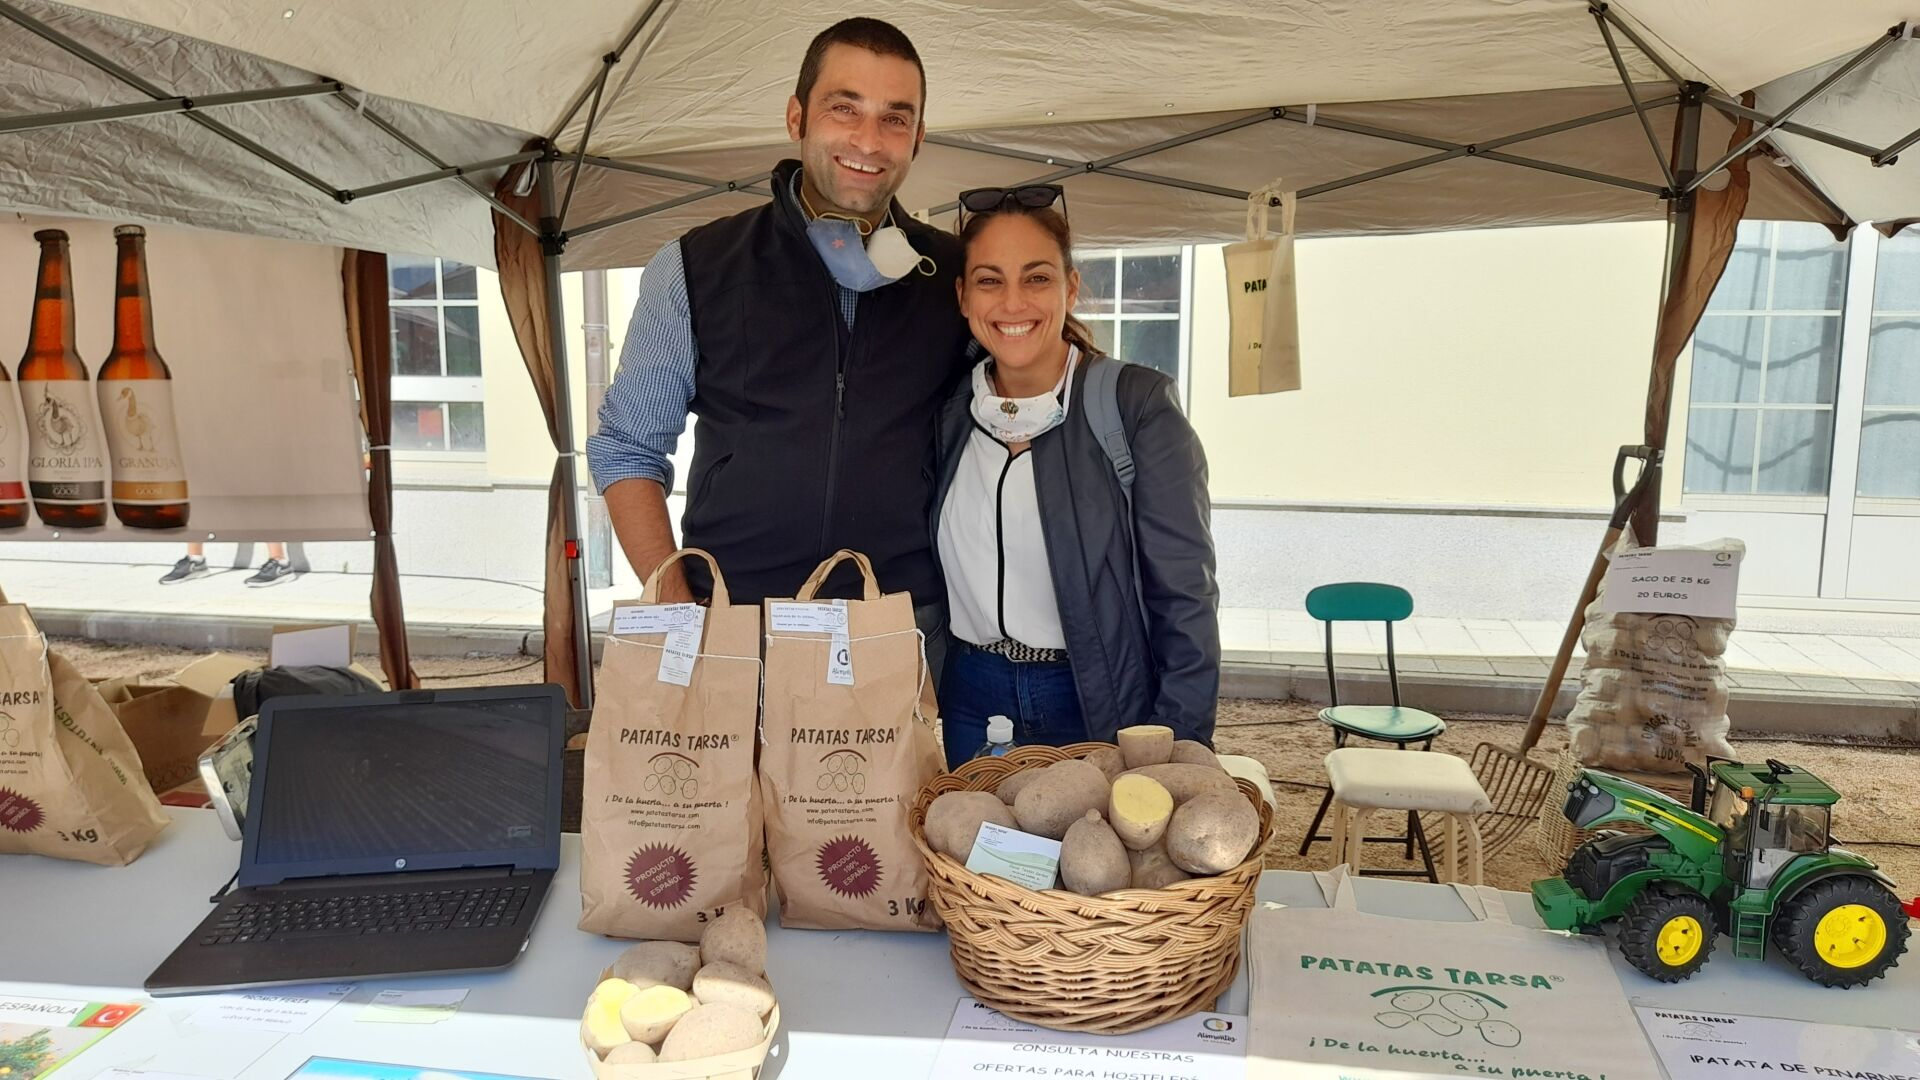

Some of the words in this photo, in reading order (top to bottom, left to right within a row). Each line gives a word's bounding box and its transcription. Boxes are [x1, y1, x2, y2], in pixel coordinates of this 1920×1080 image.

[1244, 279, 1267, 293] PATA
[31, 456, 81, 469] GLORIA
[83, 456, 103, 469] IPA
[118, 456, 178, 470] GRANUJA
[1632, 575, 1659, 583] SACO
[1663, 575, 1677, 583] DE
[1681, 576, 1693, 584] 25
[1697, 577, 1711, 585] KG
[1653, 591, 1688, 600] EUROS
[0, 690, 40, 706] ARSA
[620, 728, 681, 748] PATATAS
[790, 728, 850, 745] PATATAS
[1655, 746, 1686, 764] 100%
[611, 794, 623, 803] De
[788, 795, 798, 803] De
[72, 828, 99, 843] Kg
[827, 845, 862, 874] PRODUCTO
[843, 860, 860, 874] 100%
[634, 855, 676, 884] PRODUCTO
[651, 869, 671, 884] 100%
[887, 899, 899, 917] 3
[696, 911, 708, 923] 3
[1300, 955, 1434, 981] PATATAS
[1654, 1011, 1698, 1021] PATATAS
[1323, 1038, 1351, 1049] De
[1357, 1041, 1380, 1052] la
[1013, 1043, 1099, 1056] CONSULTA
[1106, 1048, 1195, 1064] NUESTRAS
[972, 1062, 1048, 1075] OFERTAS
[1054, 1067, 1096, 1079] PARA
[1455, 1063, 1469, 1071] a
[1477, 1065, 1503, 1075] su
[1511, 1066, 1592, 1080] puerta
[1779, 1062, 1809, 1074] DE
[1813, 1066, 1920, 1080] PINARNE
